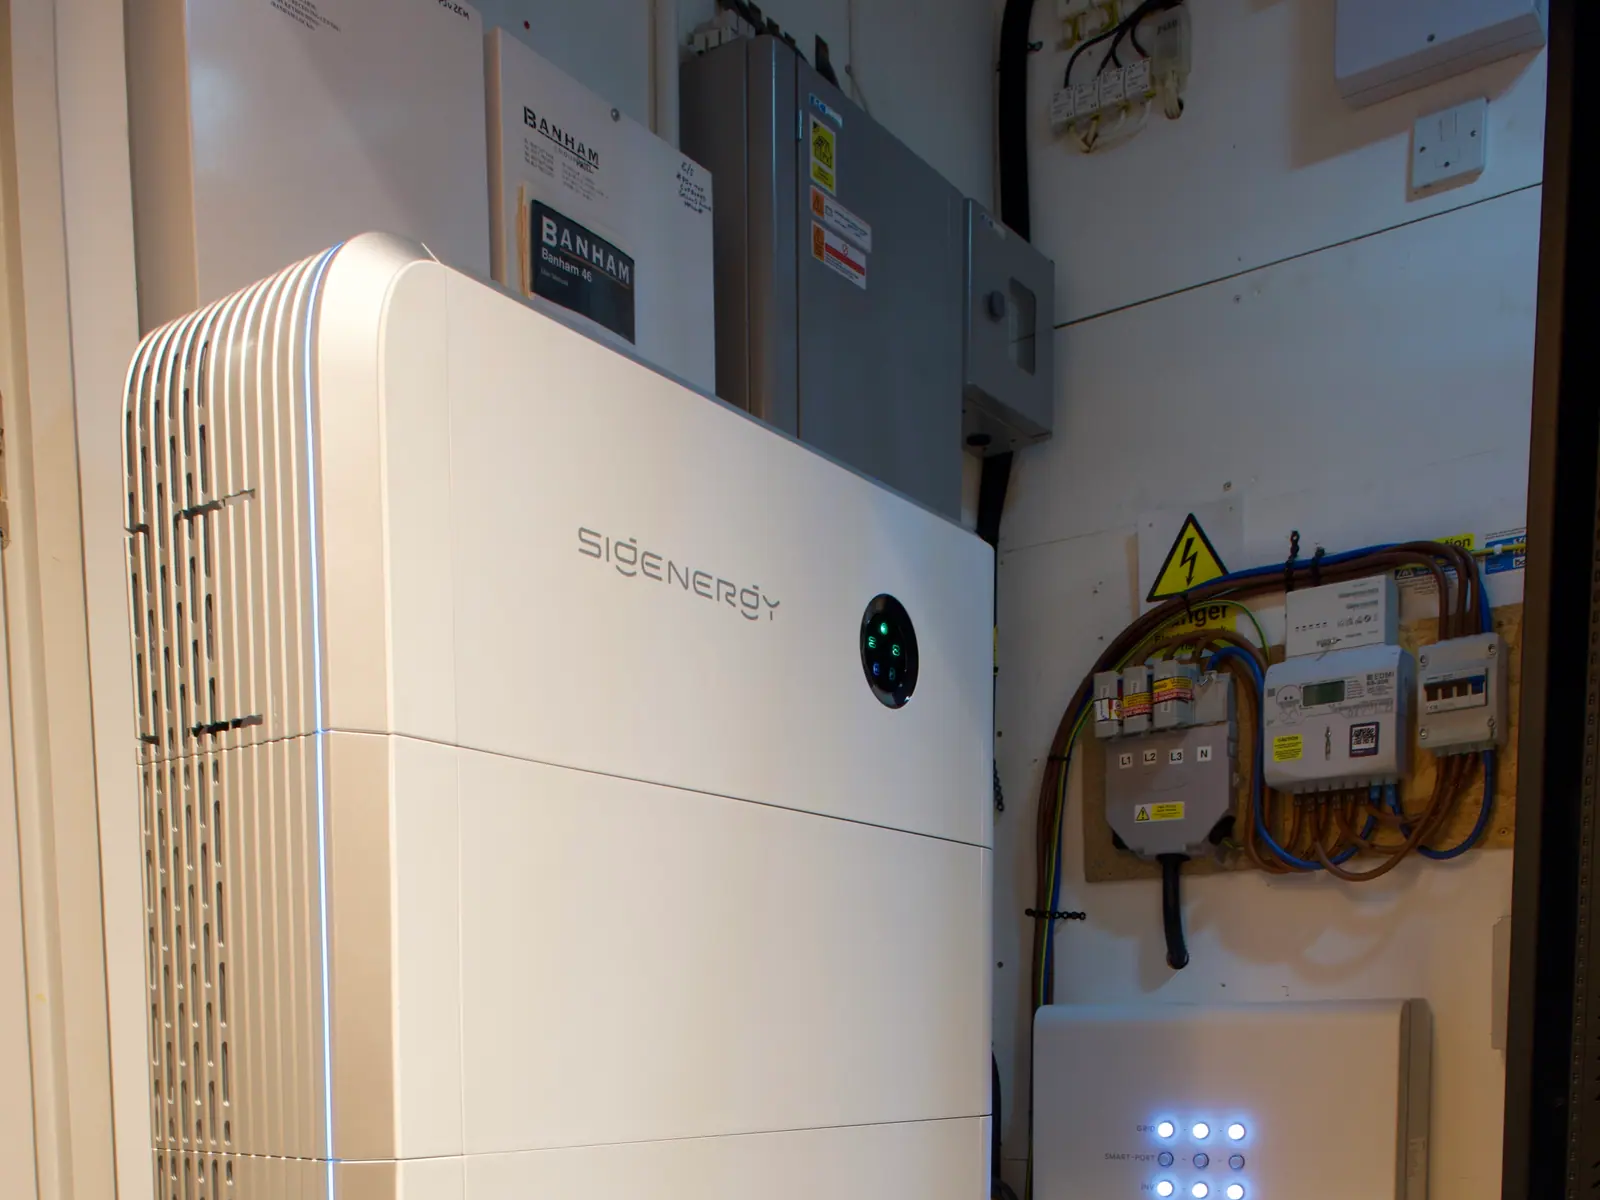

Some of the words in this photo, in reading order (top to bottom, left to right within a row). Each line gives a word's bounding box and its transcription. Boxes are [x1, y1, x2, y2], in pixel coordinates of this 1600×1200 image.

[523, 105, 600, 166] BANHAM
[541, 214, 631, 286] BANHAM
[541, 247, 580, 277] Banham
[581, 268, 593, 283] 46
[1445, 537, 1471, 548] tion
[578, 527, 780, 621] SIGENERGY
[1144, 753, 1156, 762] L2
[1170, 751, 1182, 761] L3
[1200, 749, 1208, 758] N
[1121, 756, 1131, 766] L1
[1136, 1124, 1156, 1133] GRID
[1104, 1152, 1156, 1162] SMART-PORT
[1140, 1183, 1156, 1191] INV
